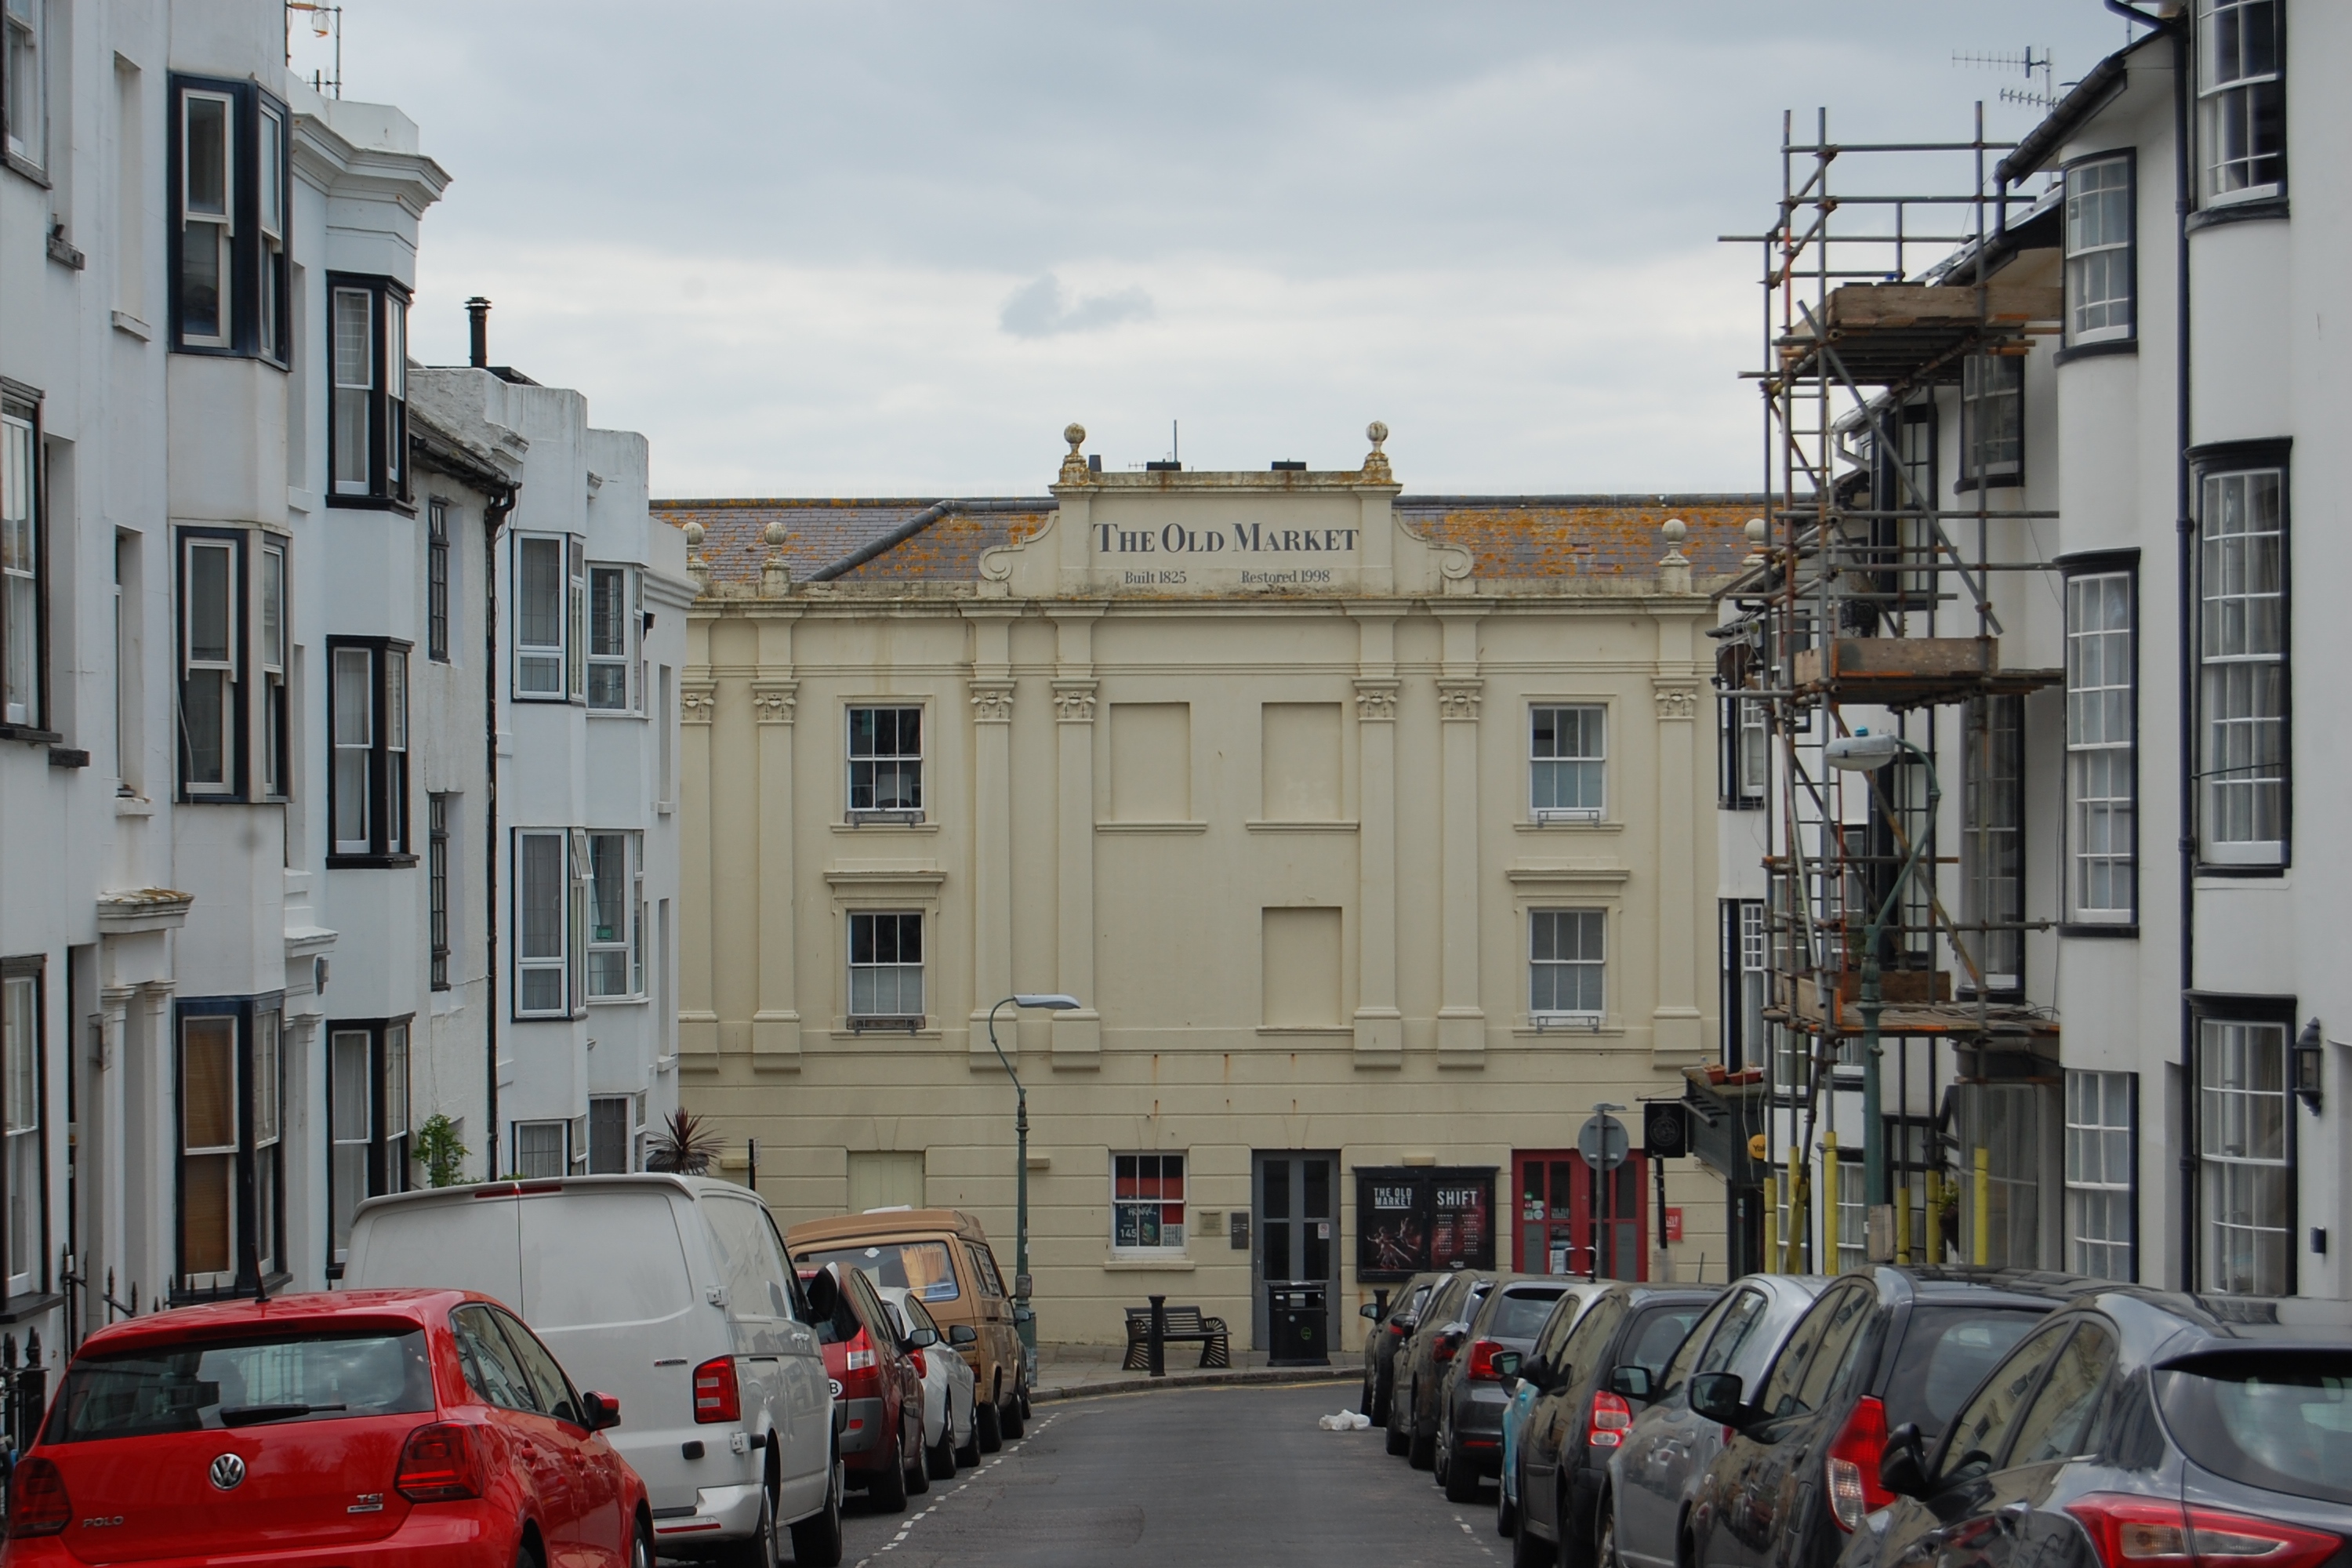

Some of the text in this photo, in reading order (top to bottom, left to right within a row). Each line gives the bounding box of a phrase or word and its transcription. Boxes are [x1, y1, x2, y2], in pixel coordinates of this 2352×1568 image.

[1125, 571, 1187, 584] Built 1825
[1241, 569, 1330, 584] Restored 1998
[1374, 1187, 1413, 1196] THE OLD
[1374, 1196, 1413, 1206] MARKET
[1436, 1190, 1478, 1205] SHIFT
[1120, 1229, 1137, 1238] 145
[357, 1493, 383, 1503] TSI
[82, 1515, 124, 1528] POLO
